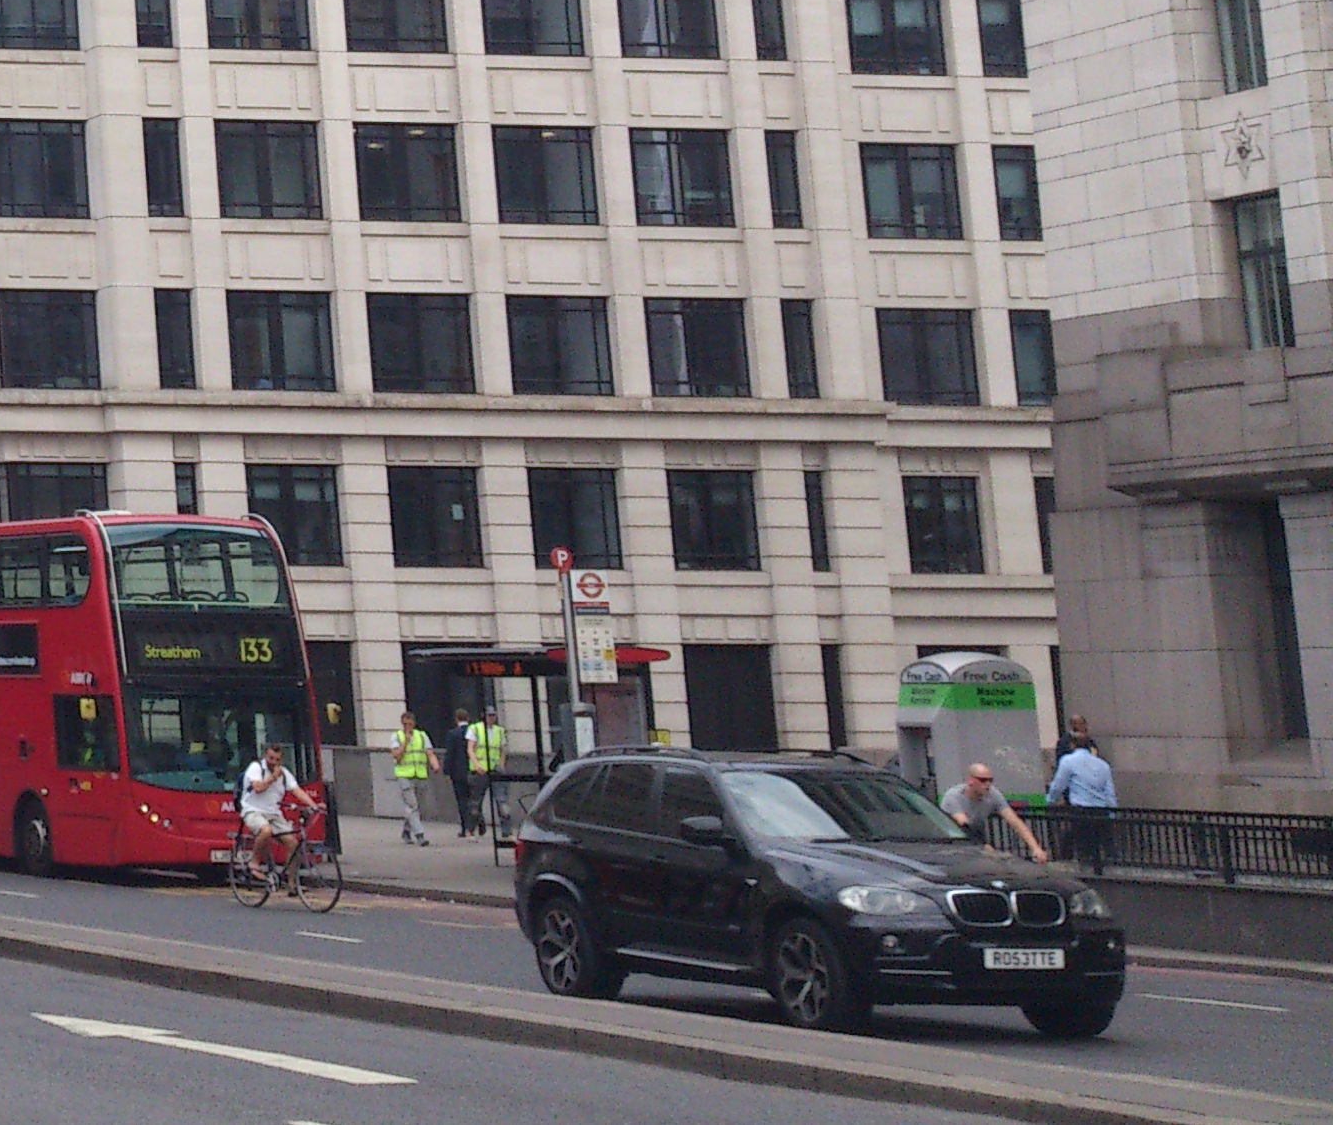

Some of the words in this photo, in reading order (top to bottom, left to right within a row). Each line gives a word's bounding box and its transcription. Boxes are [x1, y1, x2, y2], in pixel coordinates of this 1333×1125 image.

[557, 550, 569, 567] P
[144, 644, 202, 659] Streatham
[240, 637, 273, 663] 133
[963, 671, 988, 682] Free
[991, 670, 1020, 682] Cash
